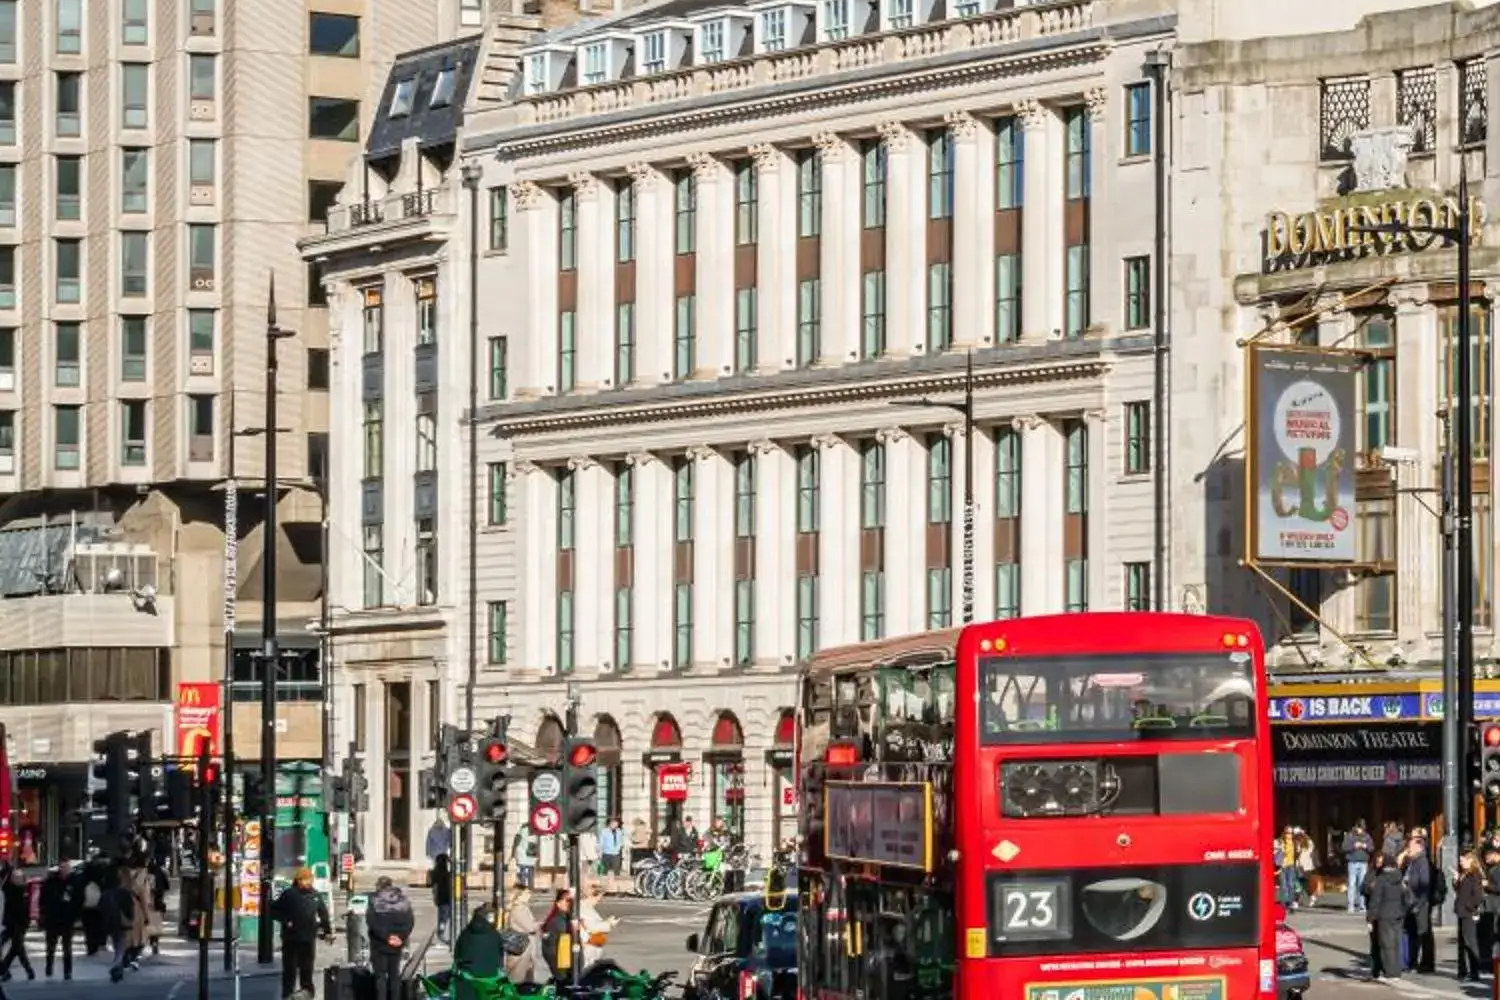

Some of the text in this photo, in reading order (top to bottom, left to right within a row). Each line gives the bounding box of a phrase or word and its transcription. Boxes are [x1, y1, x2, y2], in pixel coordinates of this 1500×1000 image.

[1266, 195, 1478, 260] DOMINION
[1309, 697, 1372, 716] IS BACK
[1281, 728, 1430, 750] DOMINION THEATRE
[1006, 891, 1054, 927] 23
